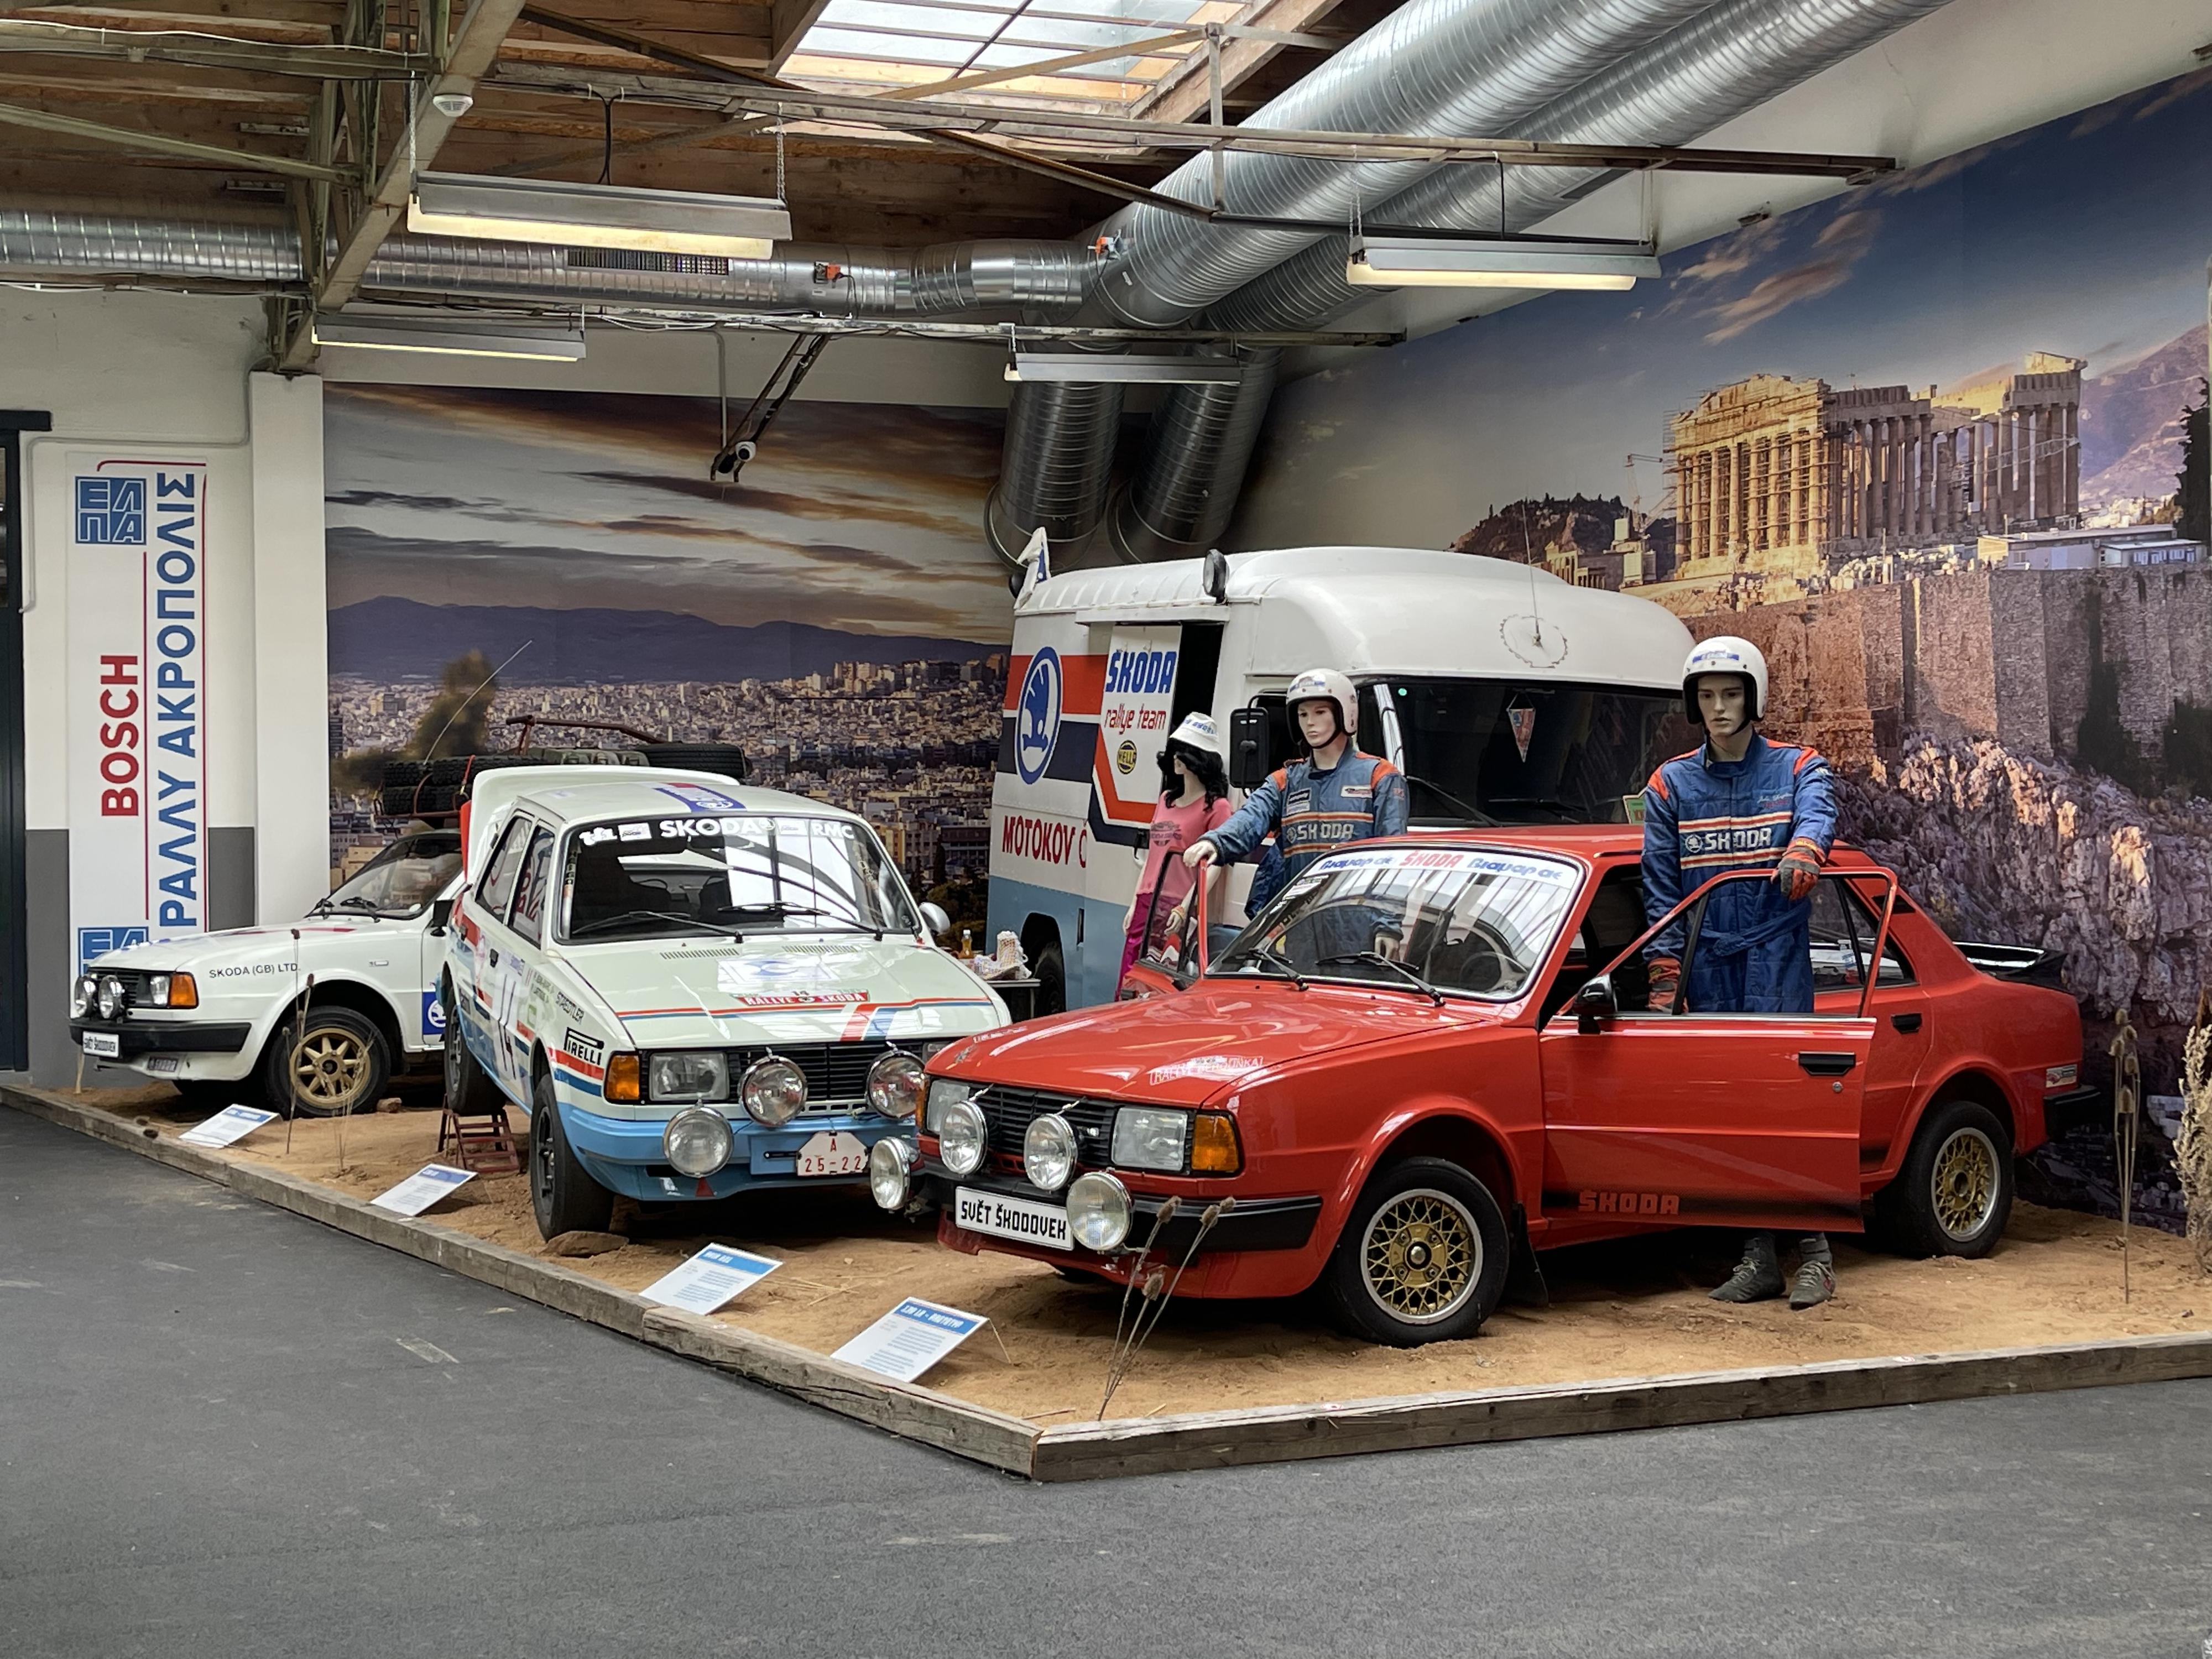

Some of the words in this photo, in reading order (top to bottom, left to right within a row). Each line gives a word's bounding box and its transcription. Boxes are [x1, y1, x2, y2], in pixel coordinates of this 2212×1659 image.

[156, 473, 196, 758] ΑΚΡΟΠΟΛΙΣ
[100, 655, 139, 817] BOSCH
[1104, 703, 1135, 735] rallye
[1136, 703, 1166, 730] team
[1002, 815, 1076, 865] MOTOKOV
[209, 967, 250, 978] SKODA
[252, 964, 275, 975] (GB)
[563, 1026, 605, 1066] PIRELLI
[830, 1138, 837, 1152] A
[961, 1199, 992, 1225] SVĚT
[995, 1203, 1067, 1240] ŠKODOVEK
